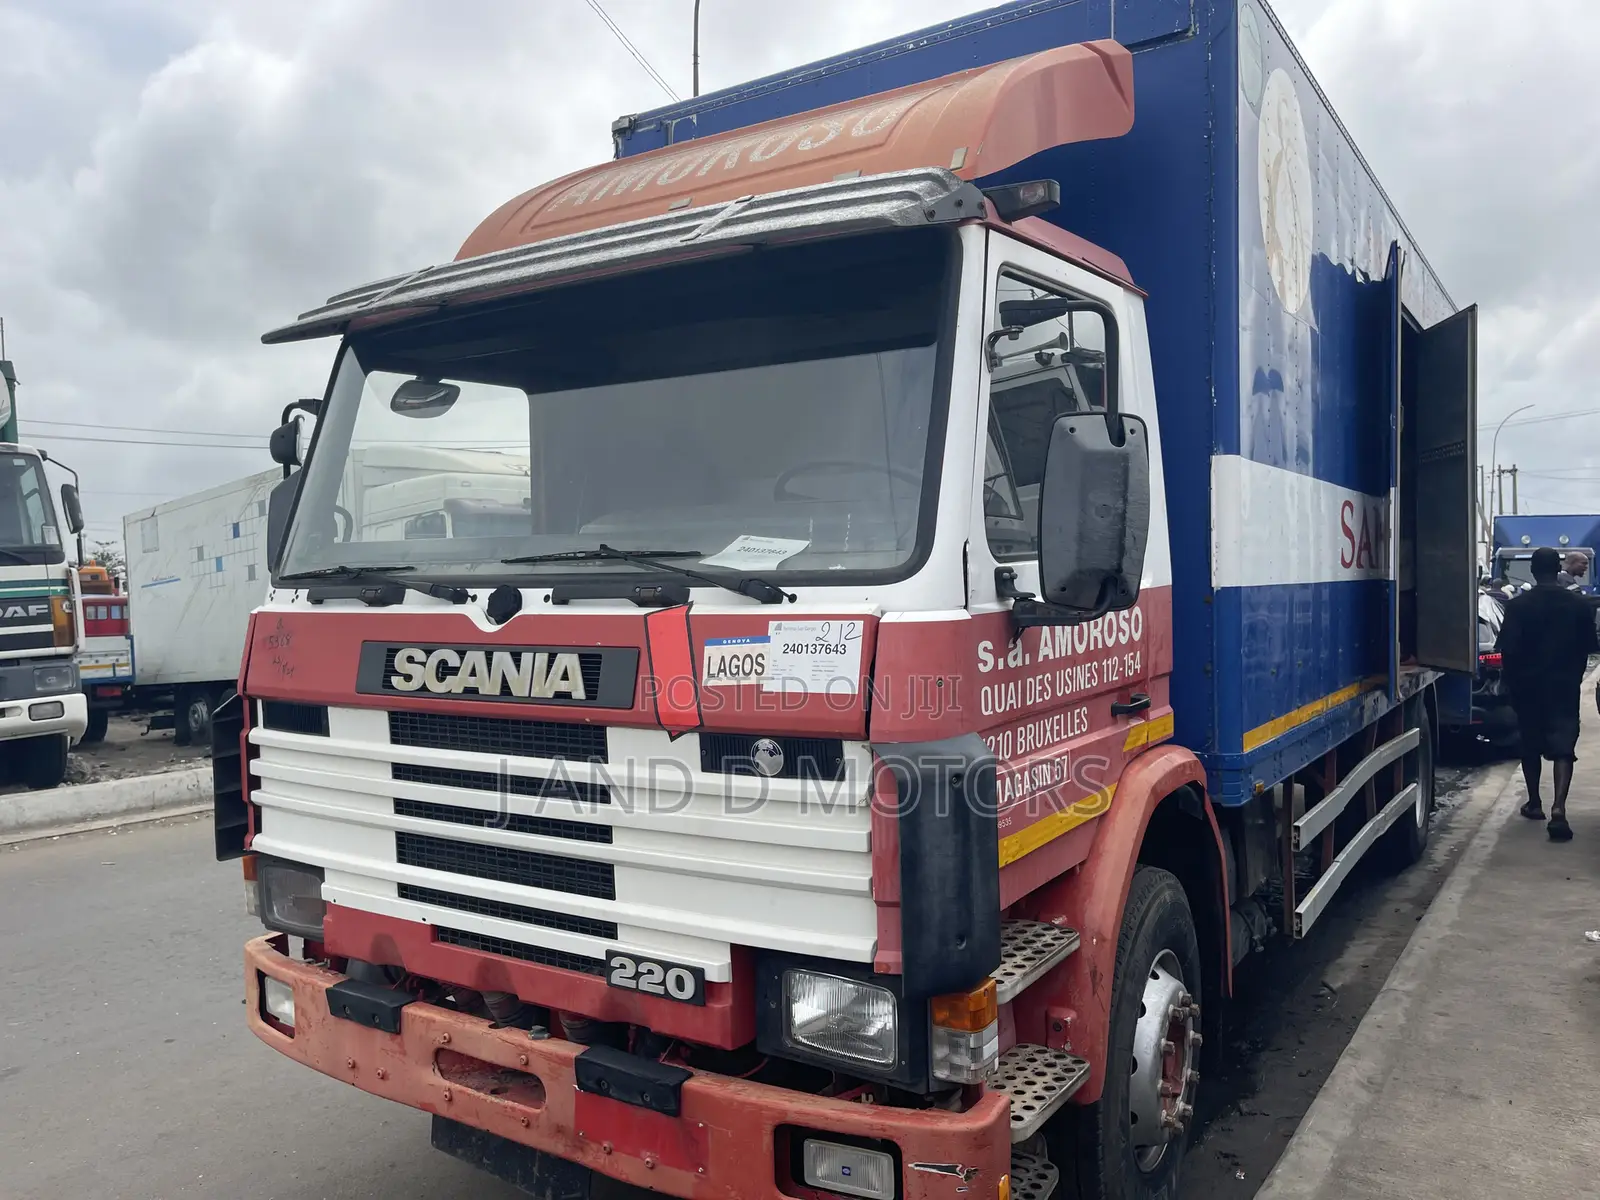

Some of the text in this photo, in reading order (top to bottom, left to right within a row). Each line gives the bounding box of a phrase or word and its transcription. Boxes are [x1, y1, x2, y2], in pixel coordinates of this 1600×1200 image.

[782, 643, 847, 655] 240137643
[1038, 606, 1143, 662] AMOROSO
[390, 647, 587, 700] SCANIA
[707, 653, 766, 678] LAGOS
[980, 651, 1142, 716] QUAI DES USINES 112-154
[1017, 706, 1088, 755] BRUXELLES
[1054, 755, 1068, 781] 57
[610, 956, 696, 1001] 220
